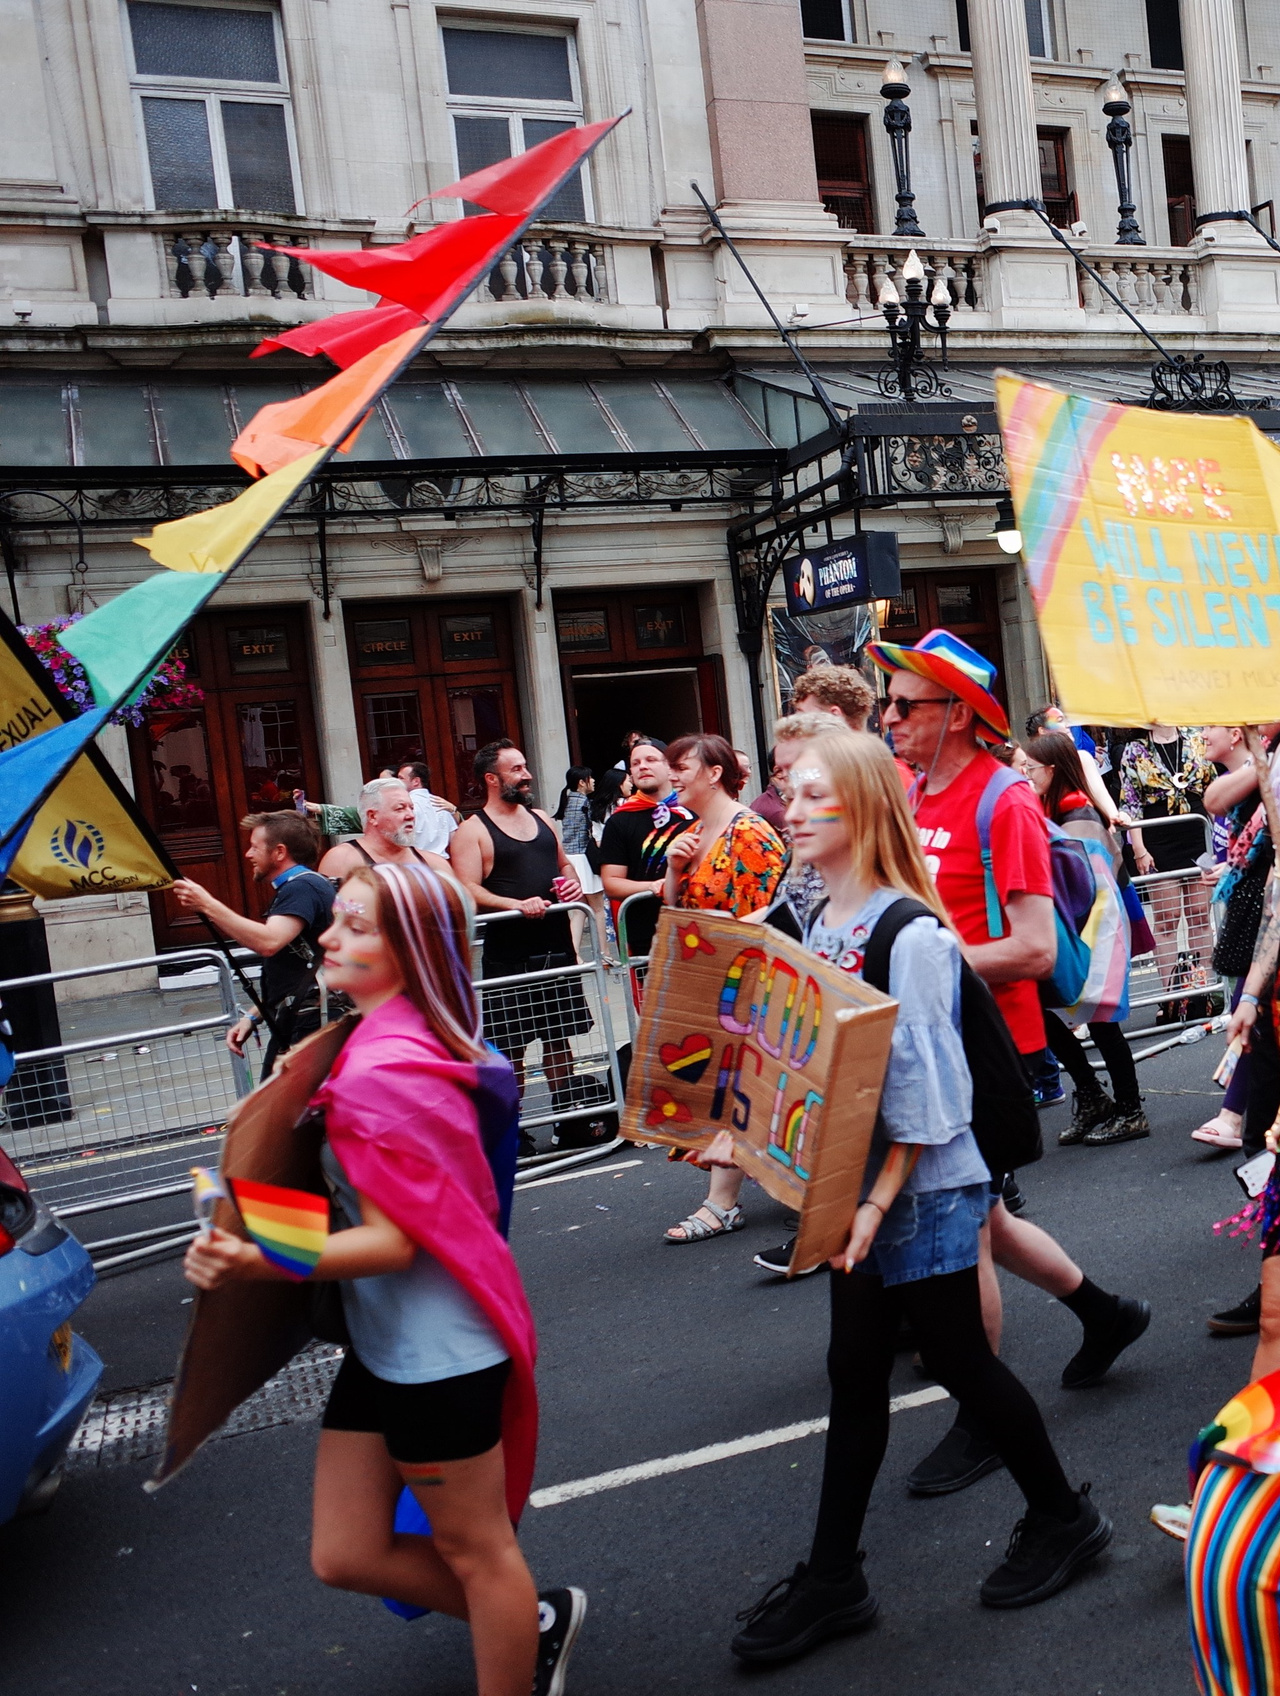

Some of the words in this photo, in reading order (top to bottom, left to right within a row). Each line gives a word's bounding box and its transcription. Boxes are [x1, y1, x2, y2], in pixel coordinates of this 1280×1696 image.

[1081, 516, 1184, 583] WILL
[818, 557, 858, 587] PHANTOM
[825, 589, 831, 599] OF
[831, 587, 840, 597] THE
[1081, 581, 1139, 644] BE
[646, 620, 674, 630] EXIT
[453, 631, 483, 642] EXIT
[243, 644, 275, 655] EXIT
[362, 641, 408, 653] CIRCLE
[69, 866, 117, 891] MCC
[709, 1042, 763, 1132] IS
